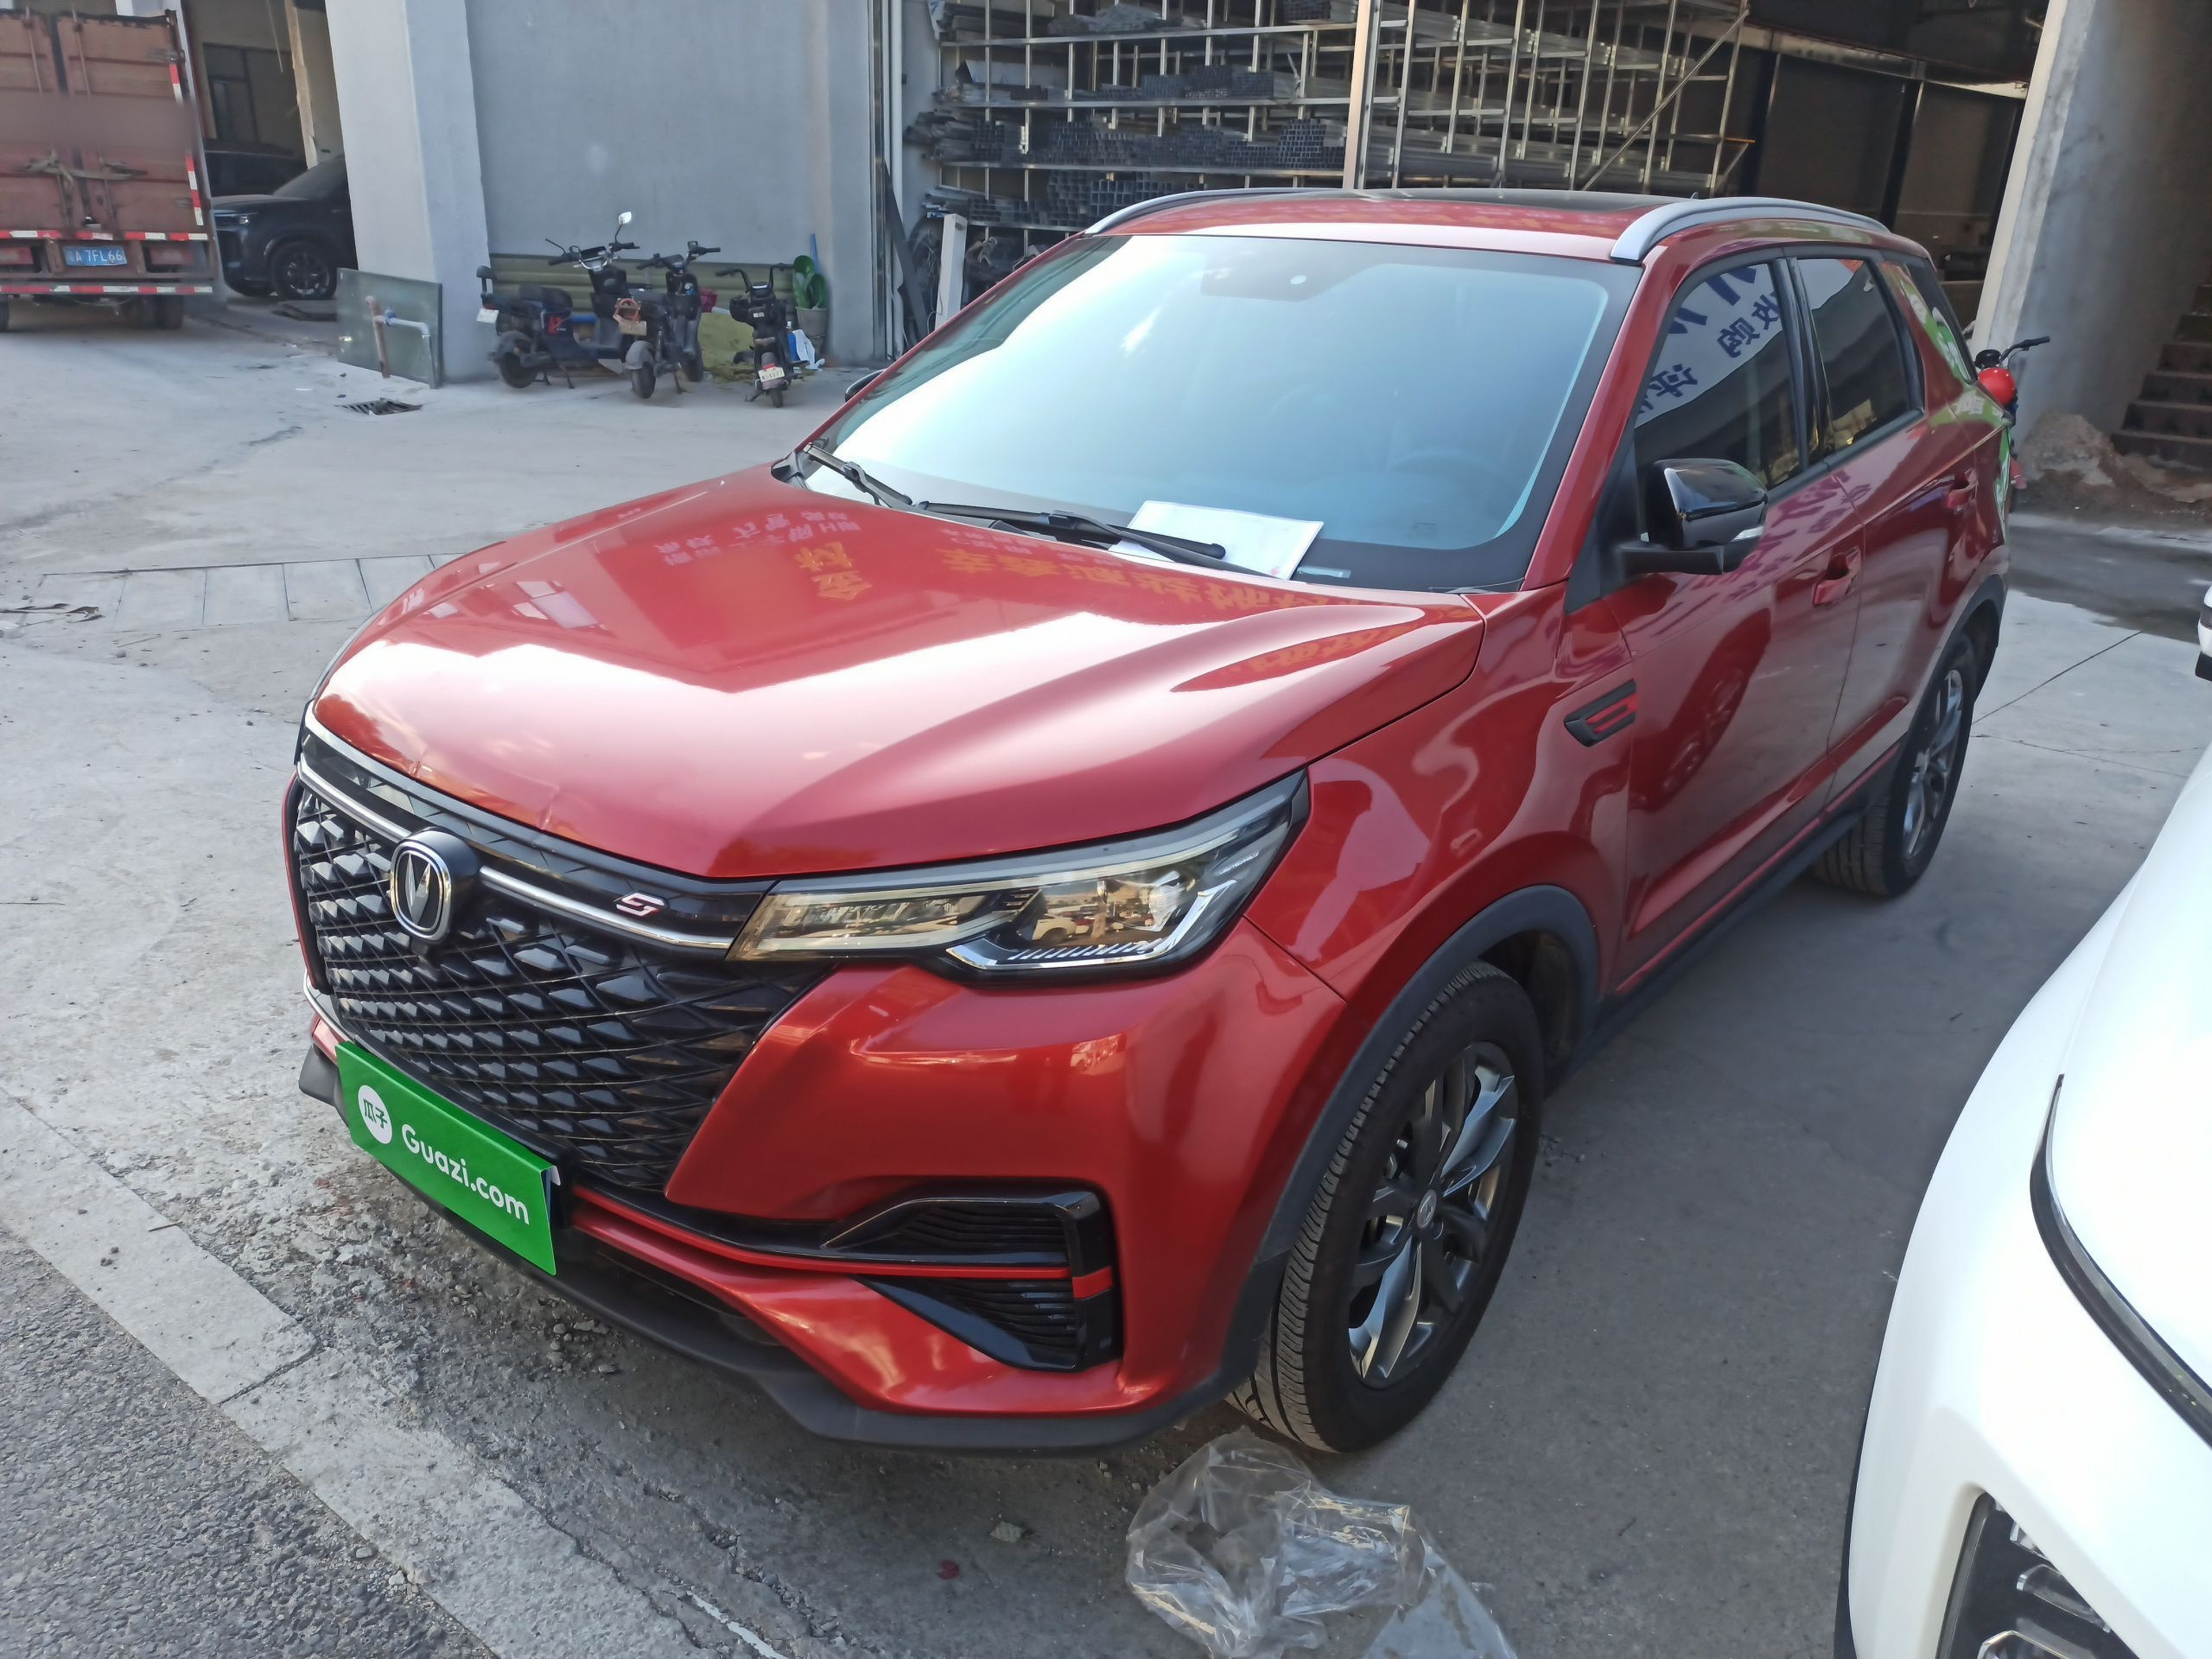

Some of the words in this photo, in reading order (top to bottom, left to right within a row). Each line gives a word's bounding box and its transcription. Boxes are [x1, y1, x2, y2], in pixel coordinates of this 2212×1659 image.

[66, 249, 123, 262] A7FL66
[362, 1099, 387, 1129] 瓜子
[402, 1124, 529, 1225] Guazi.com
